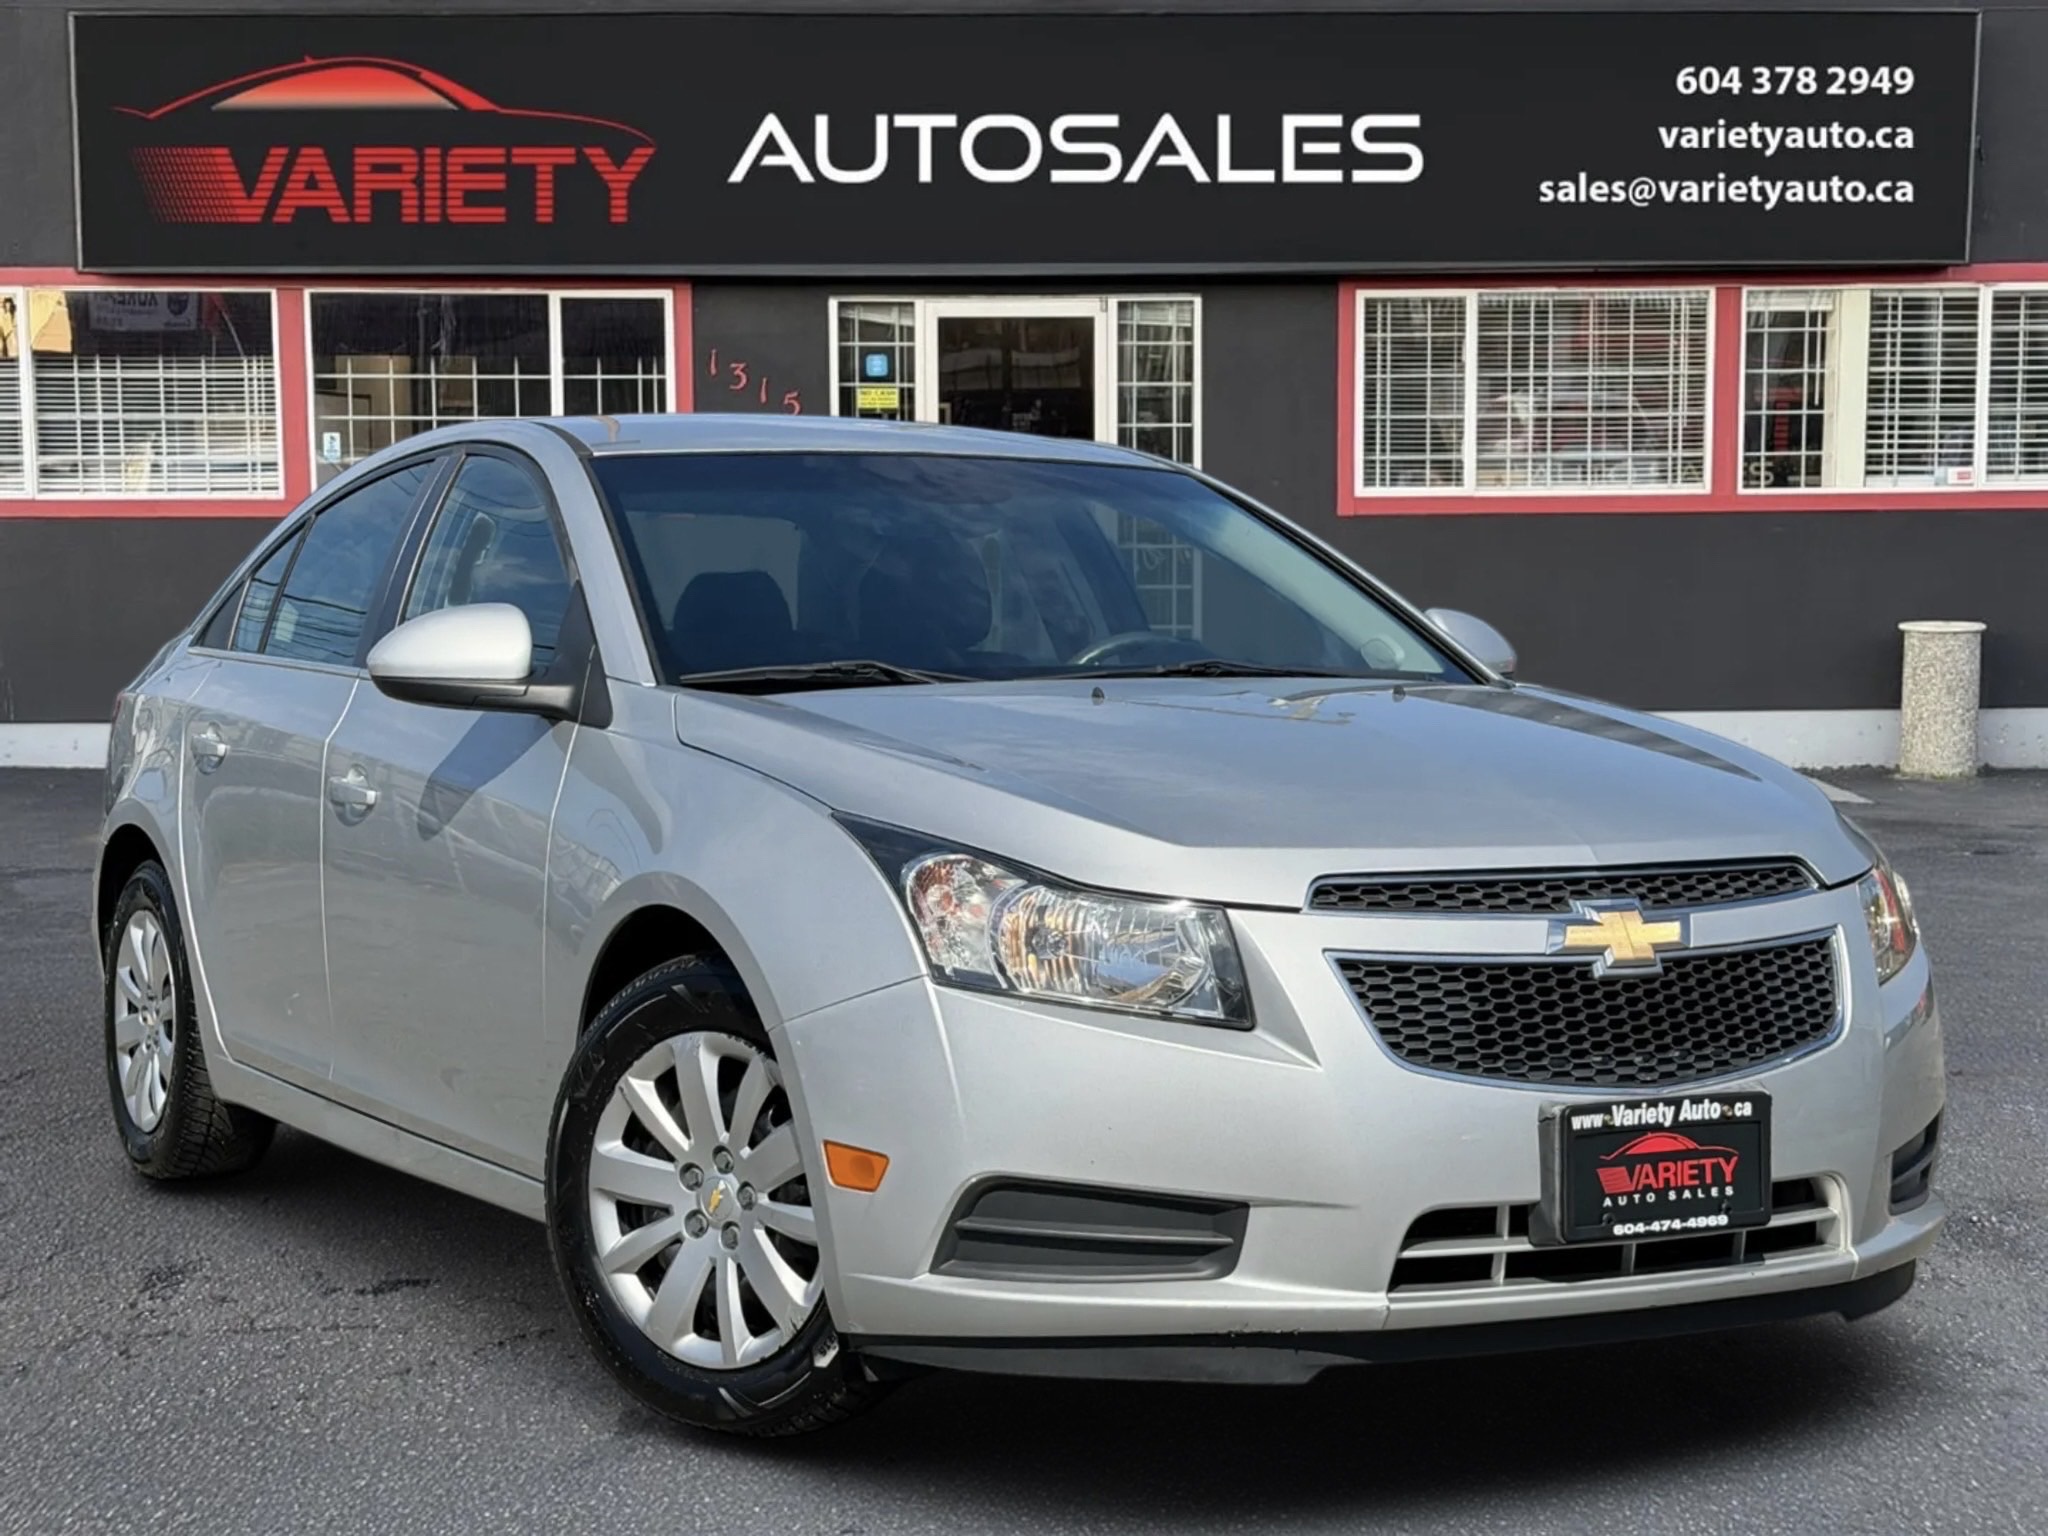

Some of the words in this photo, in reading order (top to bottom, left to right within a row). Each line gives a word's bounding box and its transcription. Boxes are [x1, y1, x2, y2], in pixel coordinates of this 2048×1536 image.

[1676, 66, 1742, 95] 604
[1751, 66, 1817, 95] 378
[1825, 66, 1915, 95] 2949
[728, 113, 1424, 184] AUTOSALES
[1658, 118, 1914, 157] varietyauto.ca
[132, 147, 656, 223] VARIETY
[1539, 171, 1914, 211] sales@varietyauto.ca
[1596, 1156, 1738, 1194] VARIETY
[1602, 1192, 1656, 1208] AUTO
[1668, 1185, 1734, 1201] SALES
